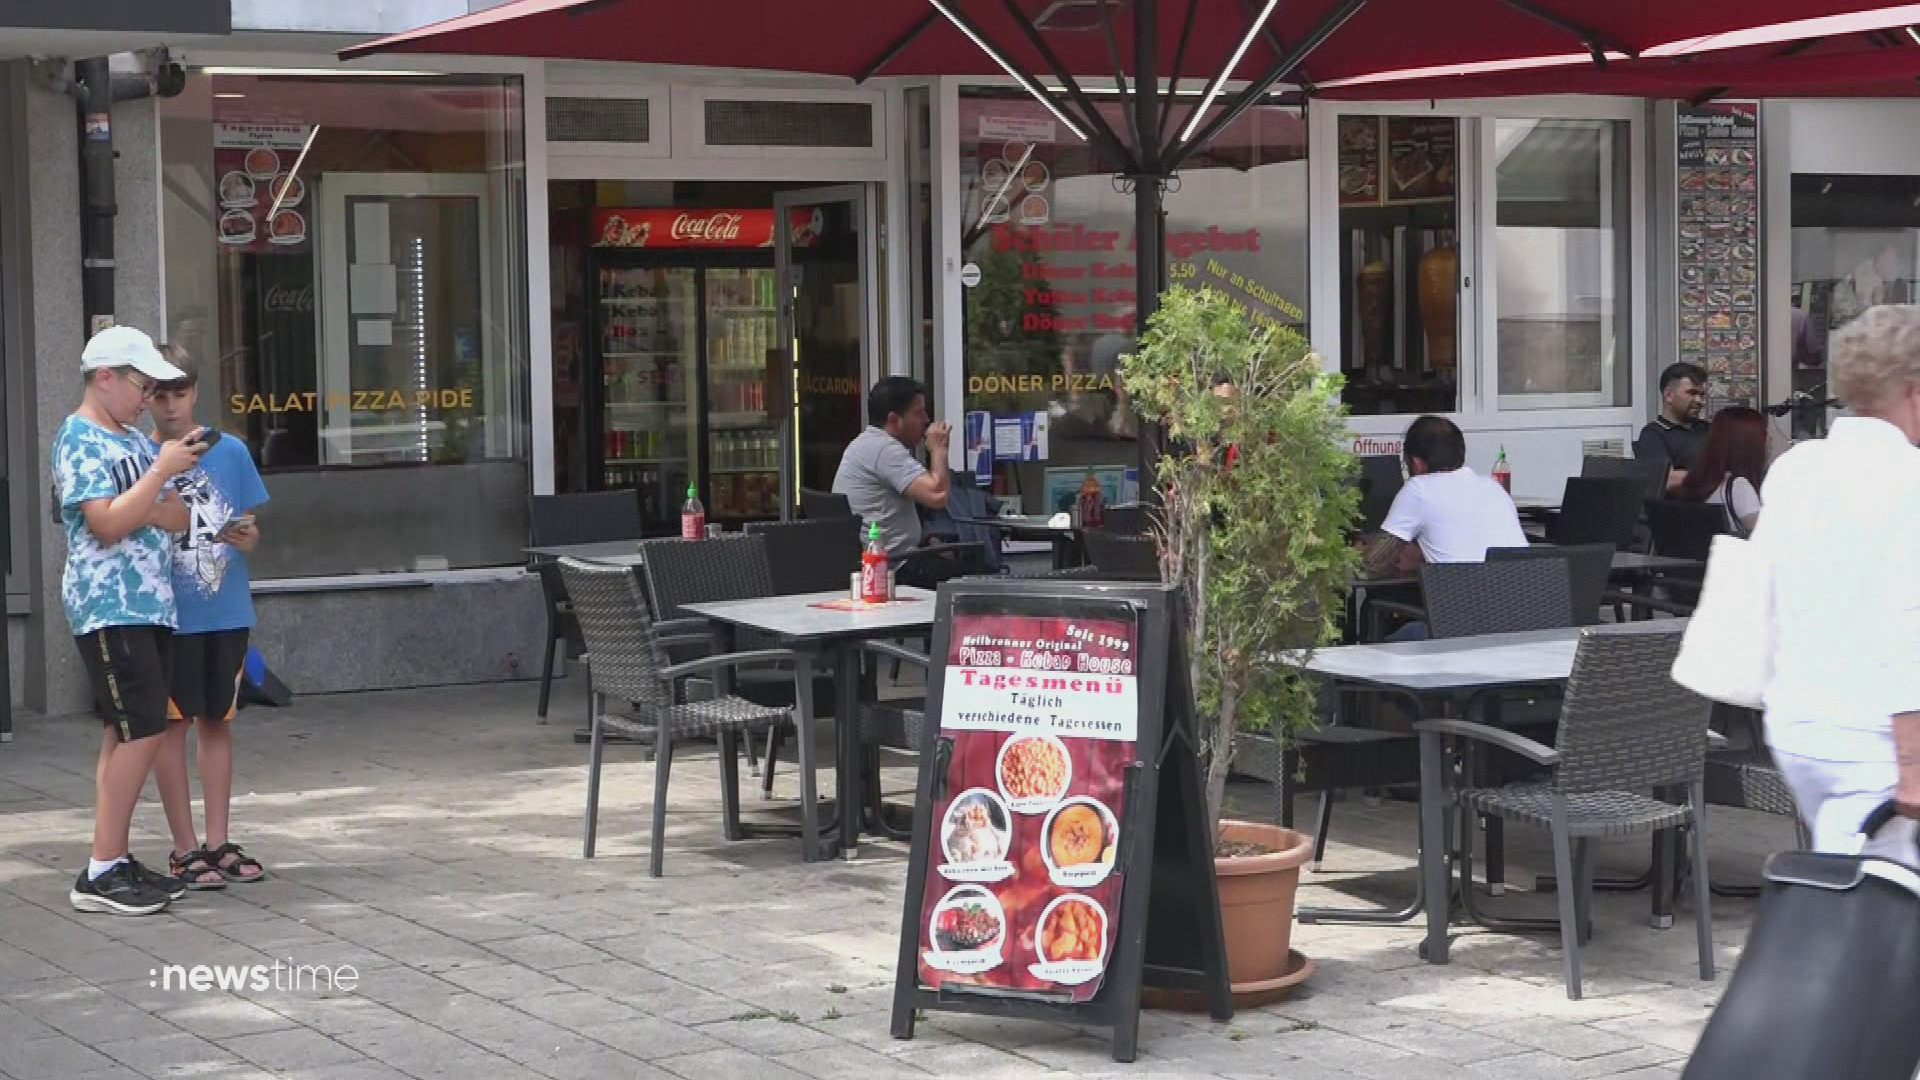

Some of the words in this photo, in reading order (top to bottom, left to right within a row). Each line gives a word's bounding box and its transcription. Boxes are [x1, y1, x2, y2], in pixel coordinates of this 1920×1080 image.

[968, 371, 1044, 394] DÖNER
[1051, 373, 1114, 391] PIZZA
[230, 392, 317, 414] SALAT
[1035, 638, 1083, 652] Original
[960, 668, 1123, 694] Tagesmenü
[1011, 692, 1063, 709] Täglich
